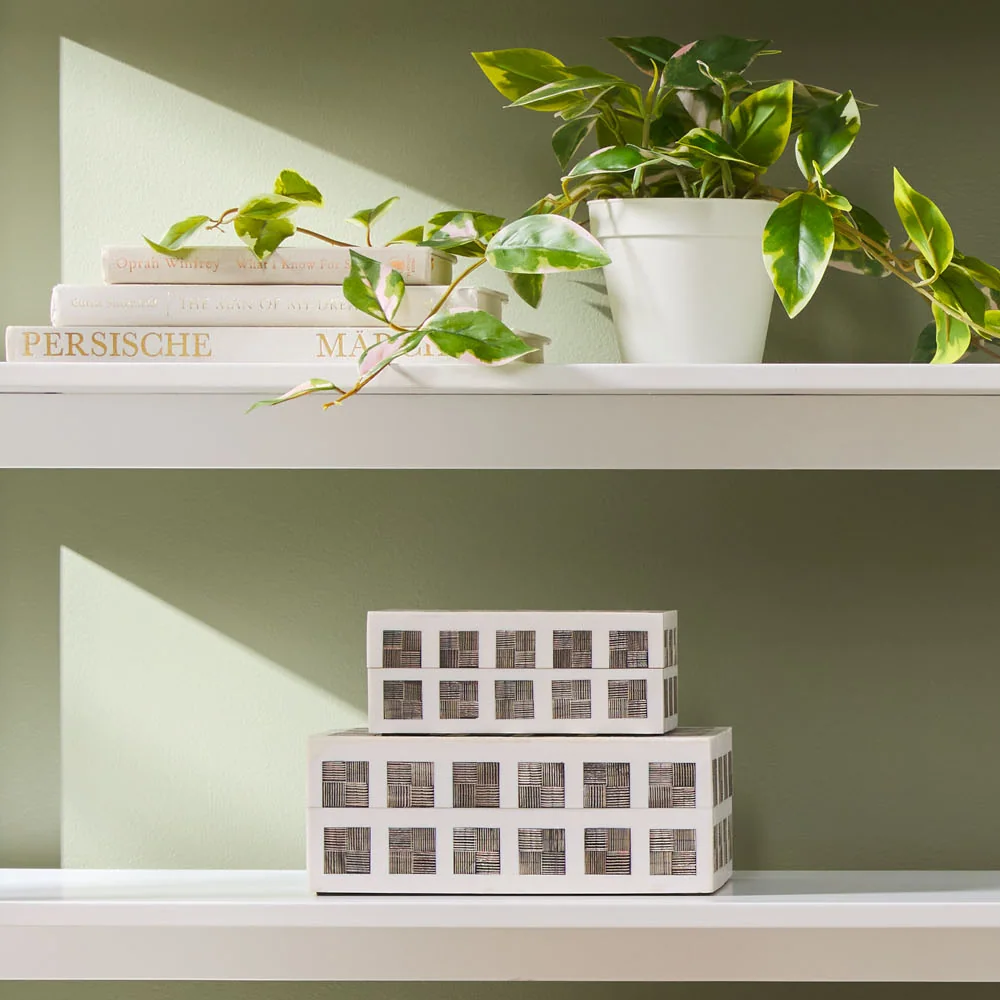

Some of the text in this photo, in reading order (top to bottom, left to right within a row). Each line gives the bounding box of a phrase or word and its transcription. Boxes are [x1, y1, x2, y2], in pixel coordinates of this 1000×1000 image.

[116, 256, 160, 273] Oprah
[165, 256, 220, 273] Winfrey
[21, 331, 213, 358] PERSISCHE
